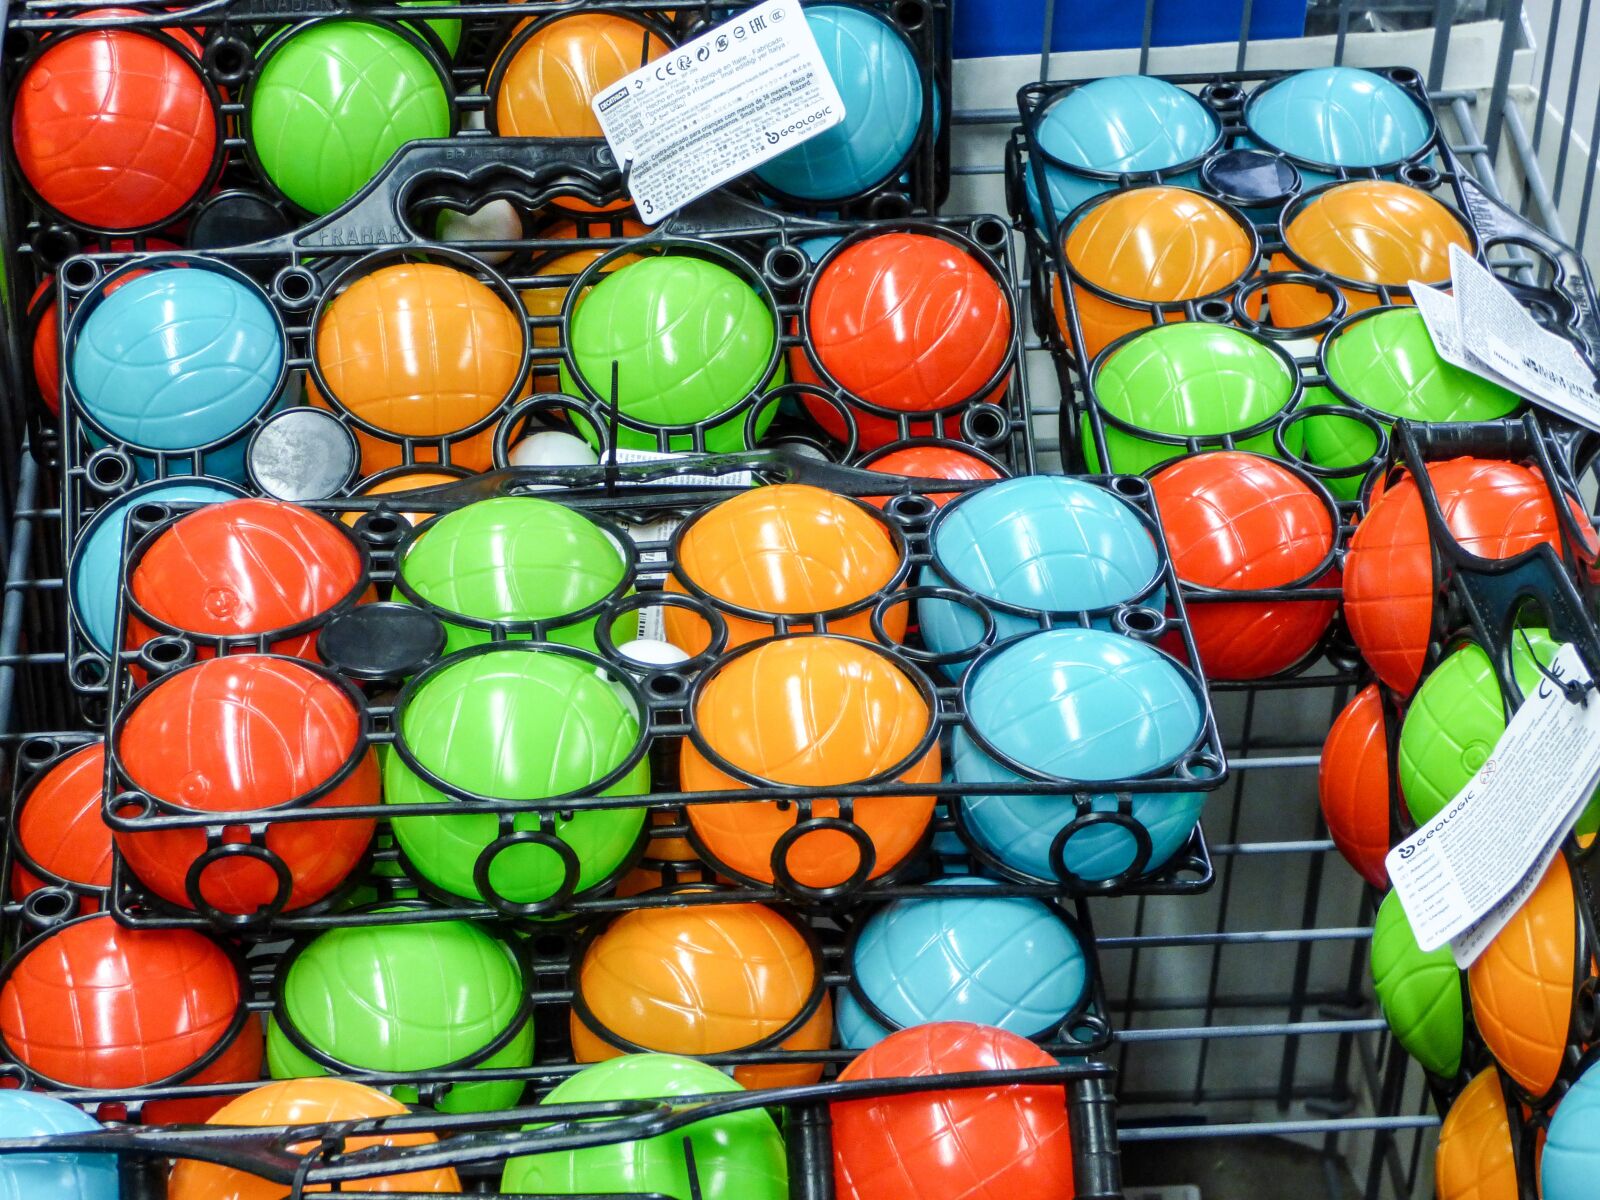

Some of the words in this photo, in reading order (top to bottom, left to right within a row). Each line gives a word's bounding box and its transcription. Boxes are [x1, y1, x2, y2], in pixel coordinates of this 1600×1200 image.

[646, 98, 665, 111] Hecho
[752, 37, 782, 54] Fabricado
[600, 89, 628, 111] DECATHLON
[780, 106, 831, 136] GEOLOGIC
[630, 160, 649, 174] Atenção
[651, 137, 688, 160] Contra-indicado
[689, 130, 701, 140] para
[702, 118, 724, 132] crianças
[724, 112, 736, 120] com
[737, 102, 754, 113] menos
[789, 77, 805, 86] Risco
[633, 166, 652, 179] ingestão
[658, 149, 677, 163] inalação
[685, 131, 712, 147] elementos
[740, 108, 755, 119] Small
[755, 102, 766, 111] ball
[770, 90, 792, 104] choking
[792, 80, 811, 93] hazard.
[643, 199, 653, 214] 3
[319, 224, 401, 247] FRABAR
[1416, 790, 1476, 847] GEOLOGIC
